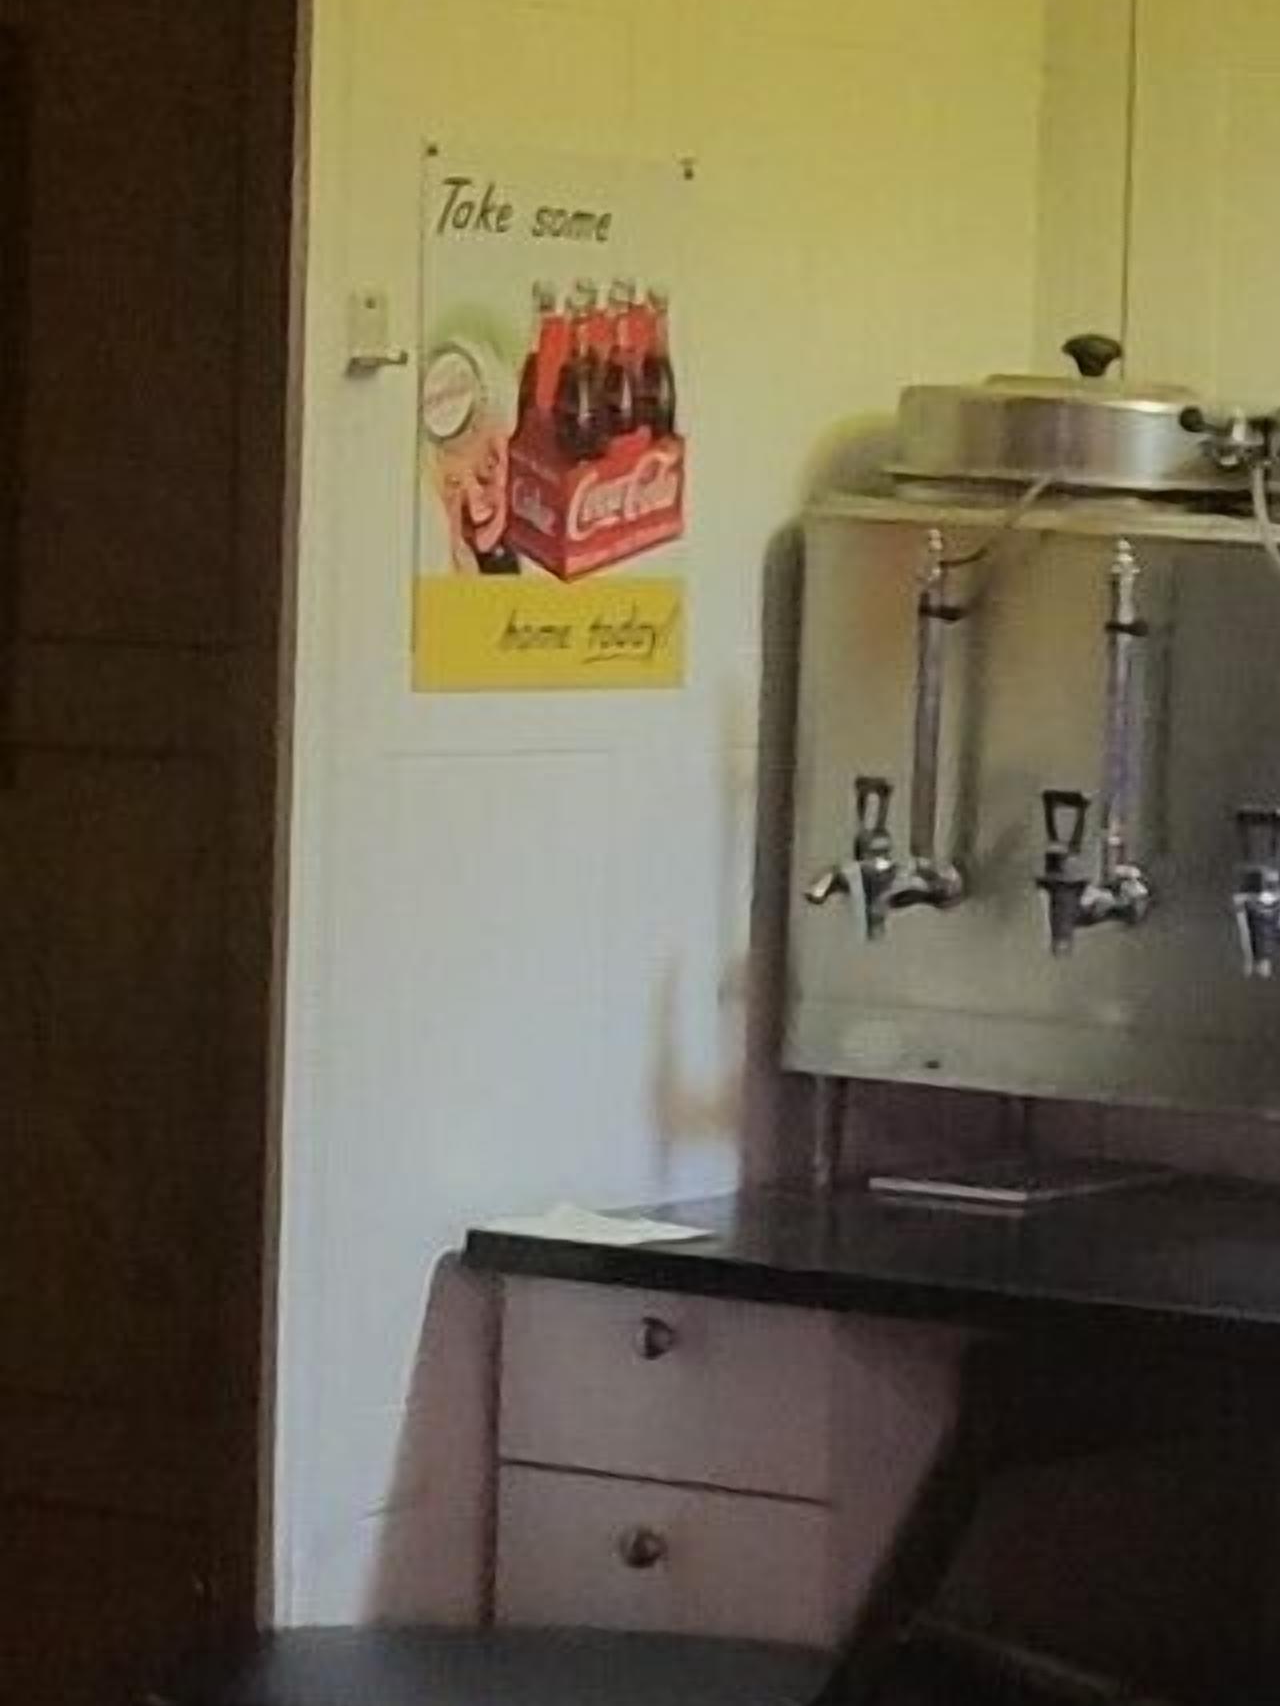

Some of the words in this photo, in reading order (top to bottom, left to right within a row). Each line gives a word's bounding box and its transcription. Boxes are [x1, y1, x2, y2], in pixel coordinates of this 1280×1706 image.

[437, 176, 513, 235] Take
[532, 206, 612, 242] some
[500, 609, 573, 651] home
